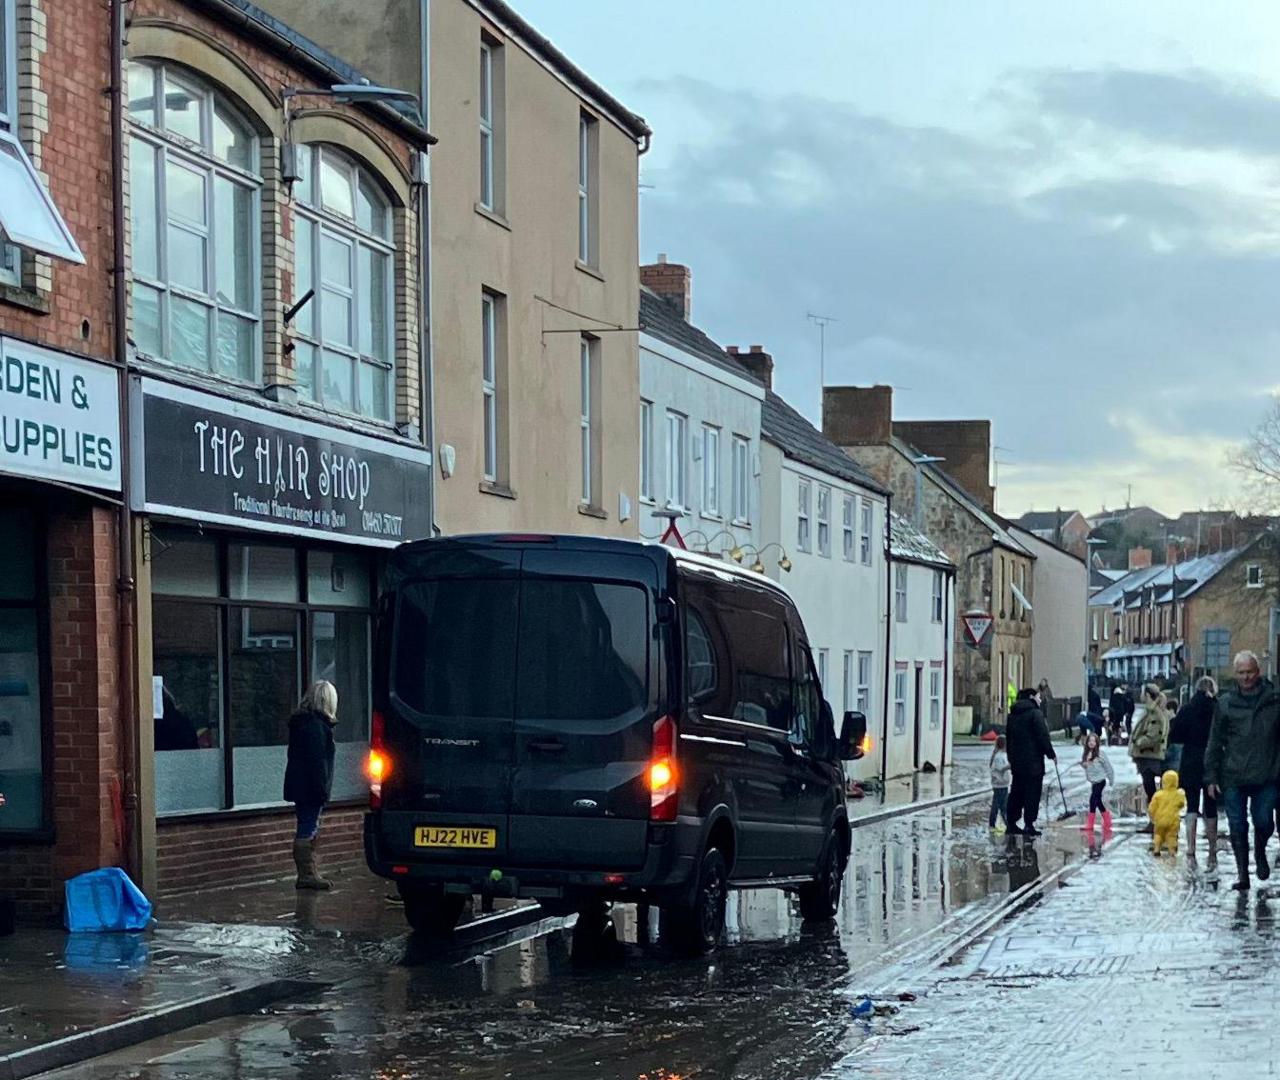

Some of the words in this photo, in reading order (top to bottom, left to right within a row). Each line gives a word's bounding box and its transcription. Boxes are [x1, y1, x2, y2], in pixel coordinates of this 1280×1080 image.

[71, 374, 90, 410] &
[194, 419, 245, 479] THE
[318, 450, 371, 511] SHOP
[232, 491, 270, 515] Traditional
[420, 829, 457, 844] HJ22
[461, 830, 489, 845] HVE
